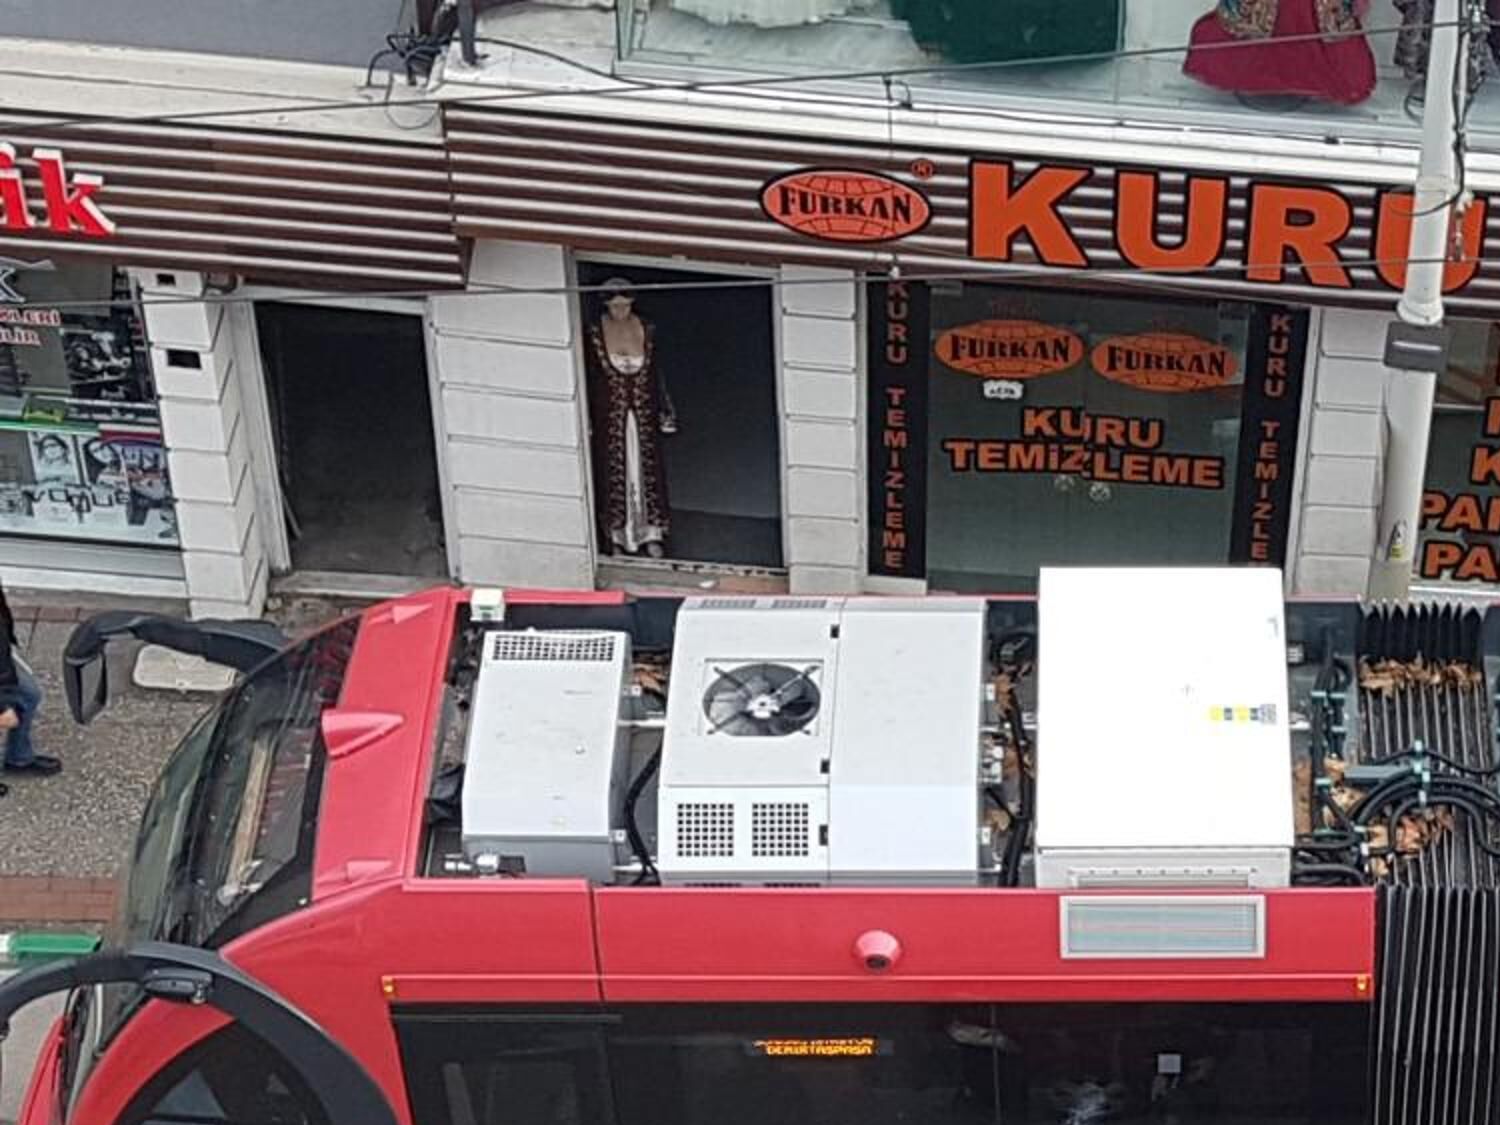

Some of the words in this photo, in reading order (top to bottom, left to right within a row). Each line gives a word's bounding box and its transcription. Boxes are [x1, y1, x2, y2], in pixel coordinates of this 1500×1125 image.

[778, 184, 912, 224] FURKAN
[967, 159, 1489, 294] KURU
[949, 334, 1070, 363] FURKAN
[1106, 346, 1226, 378] FURKAN
[1263, 313, 1291, 398] KURU
[1023, 408, 1161, 449] KURU
